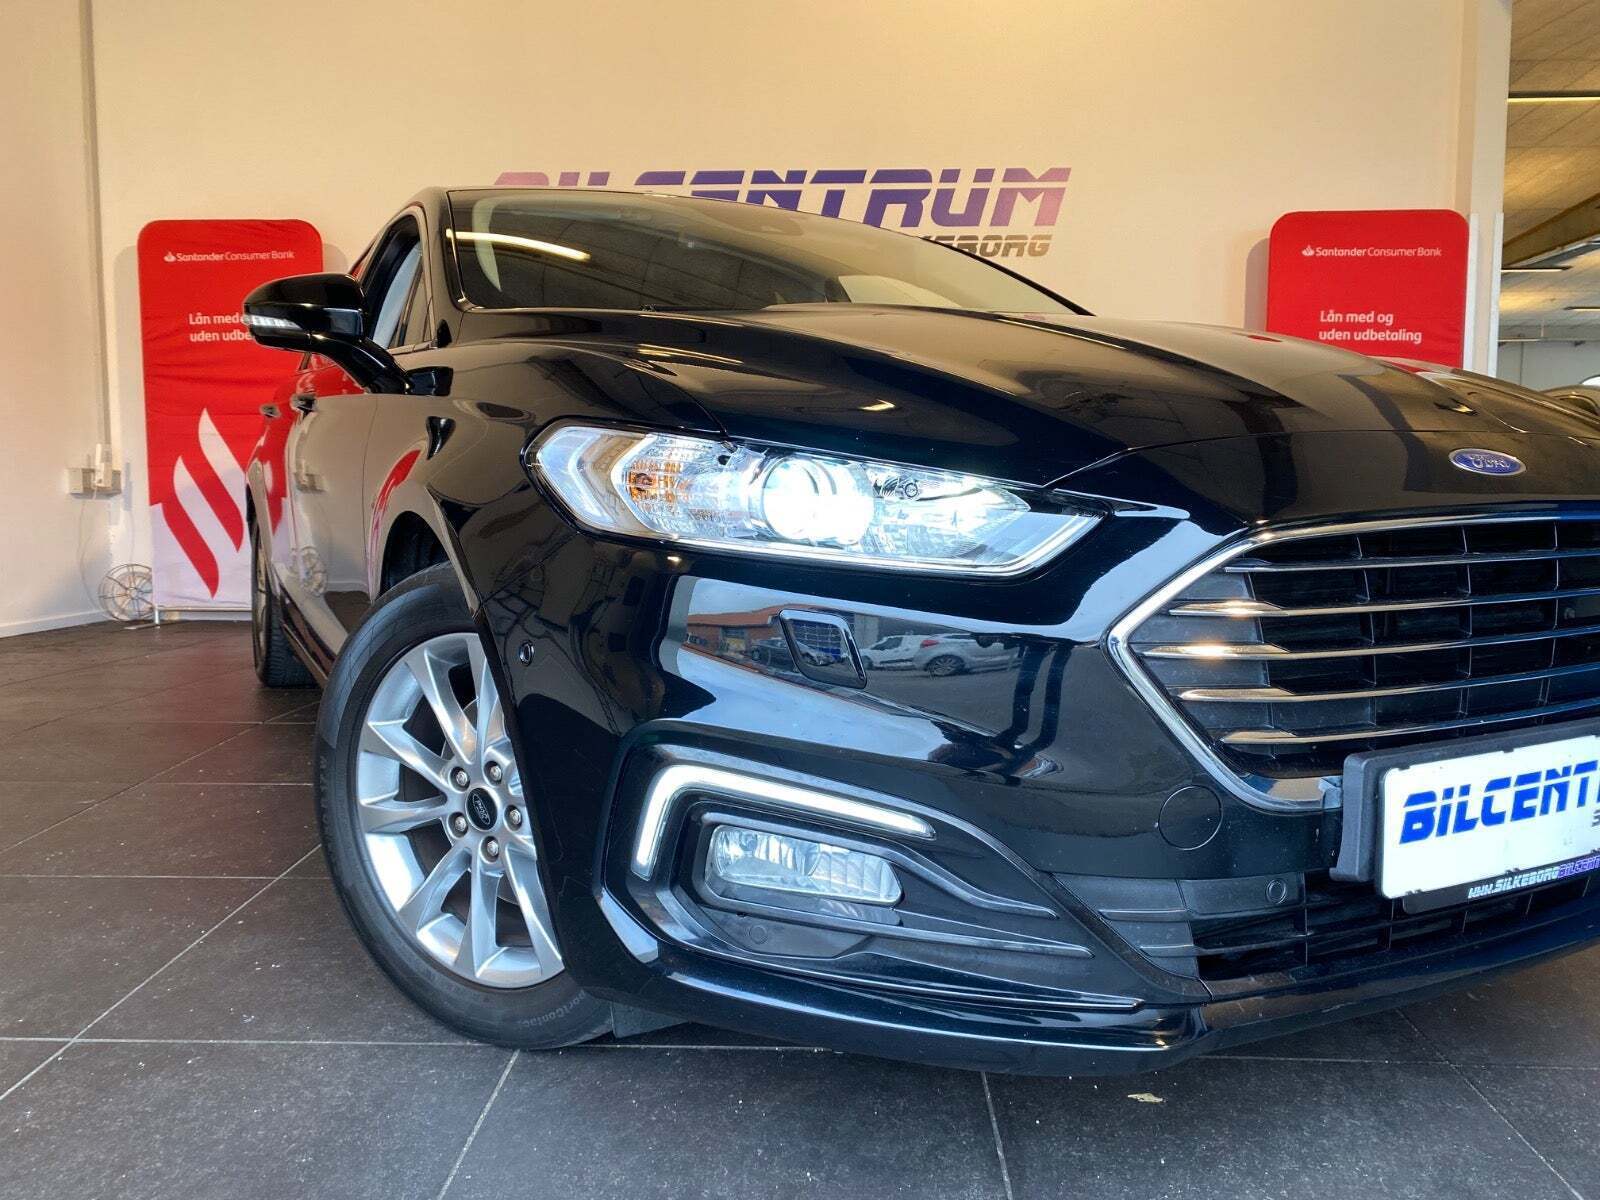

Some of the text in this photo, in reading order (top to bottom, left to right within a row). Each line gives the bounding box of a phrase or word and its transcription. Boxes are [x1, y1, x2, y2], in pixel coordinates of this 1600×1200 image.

[176, 250, 295, 262] Santander Consumer Bank
[1315, 247, 1441, 257] Santander Consumer Bank
[189, 312, 239, 325] Lån med
[1320, 309, 1394, 326] Lån med og
[190, 329, 254, 342] uden udbe
[1319, 328, 1422, 344] uden udbetaling
[1400, 760, 1600, 844] BILCENT
